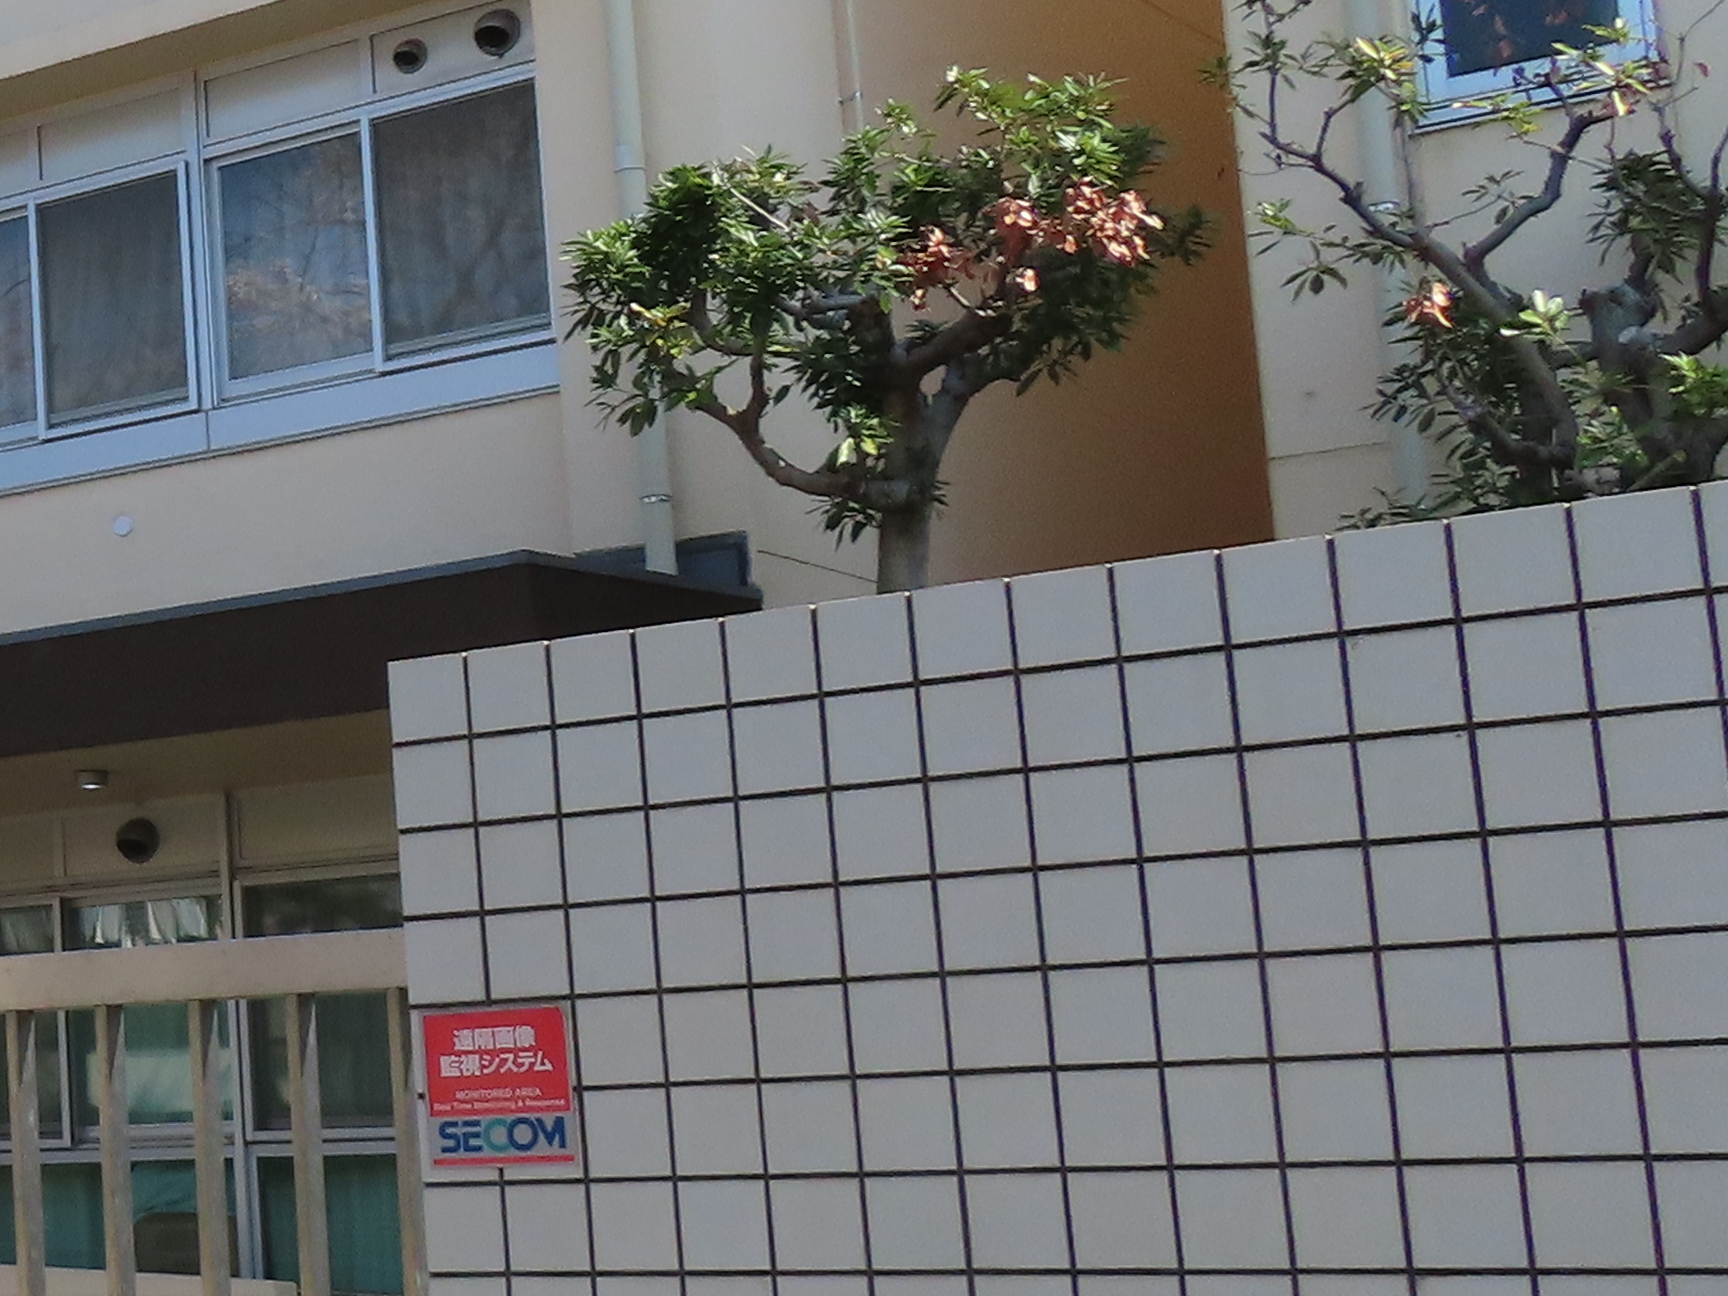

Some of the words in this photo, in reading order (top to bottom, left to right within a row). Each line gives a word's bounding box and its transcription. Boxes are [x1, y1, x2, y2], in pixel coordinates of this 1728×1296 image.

[440, 1051, 554, 1077] 監視システム
[439, 1116, 567, 1153] SECOM
